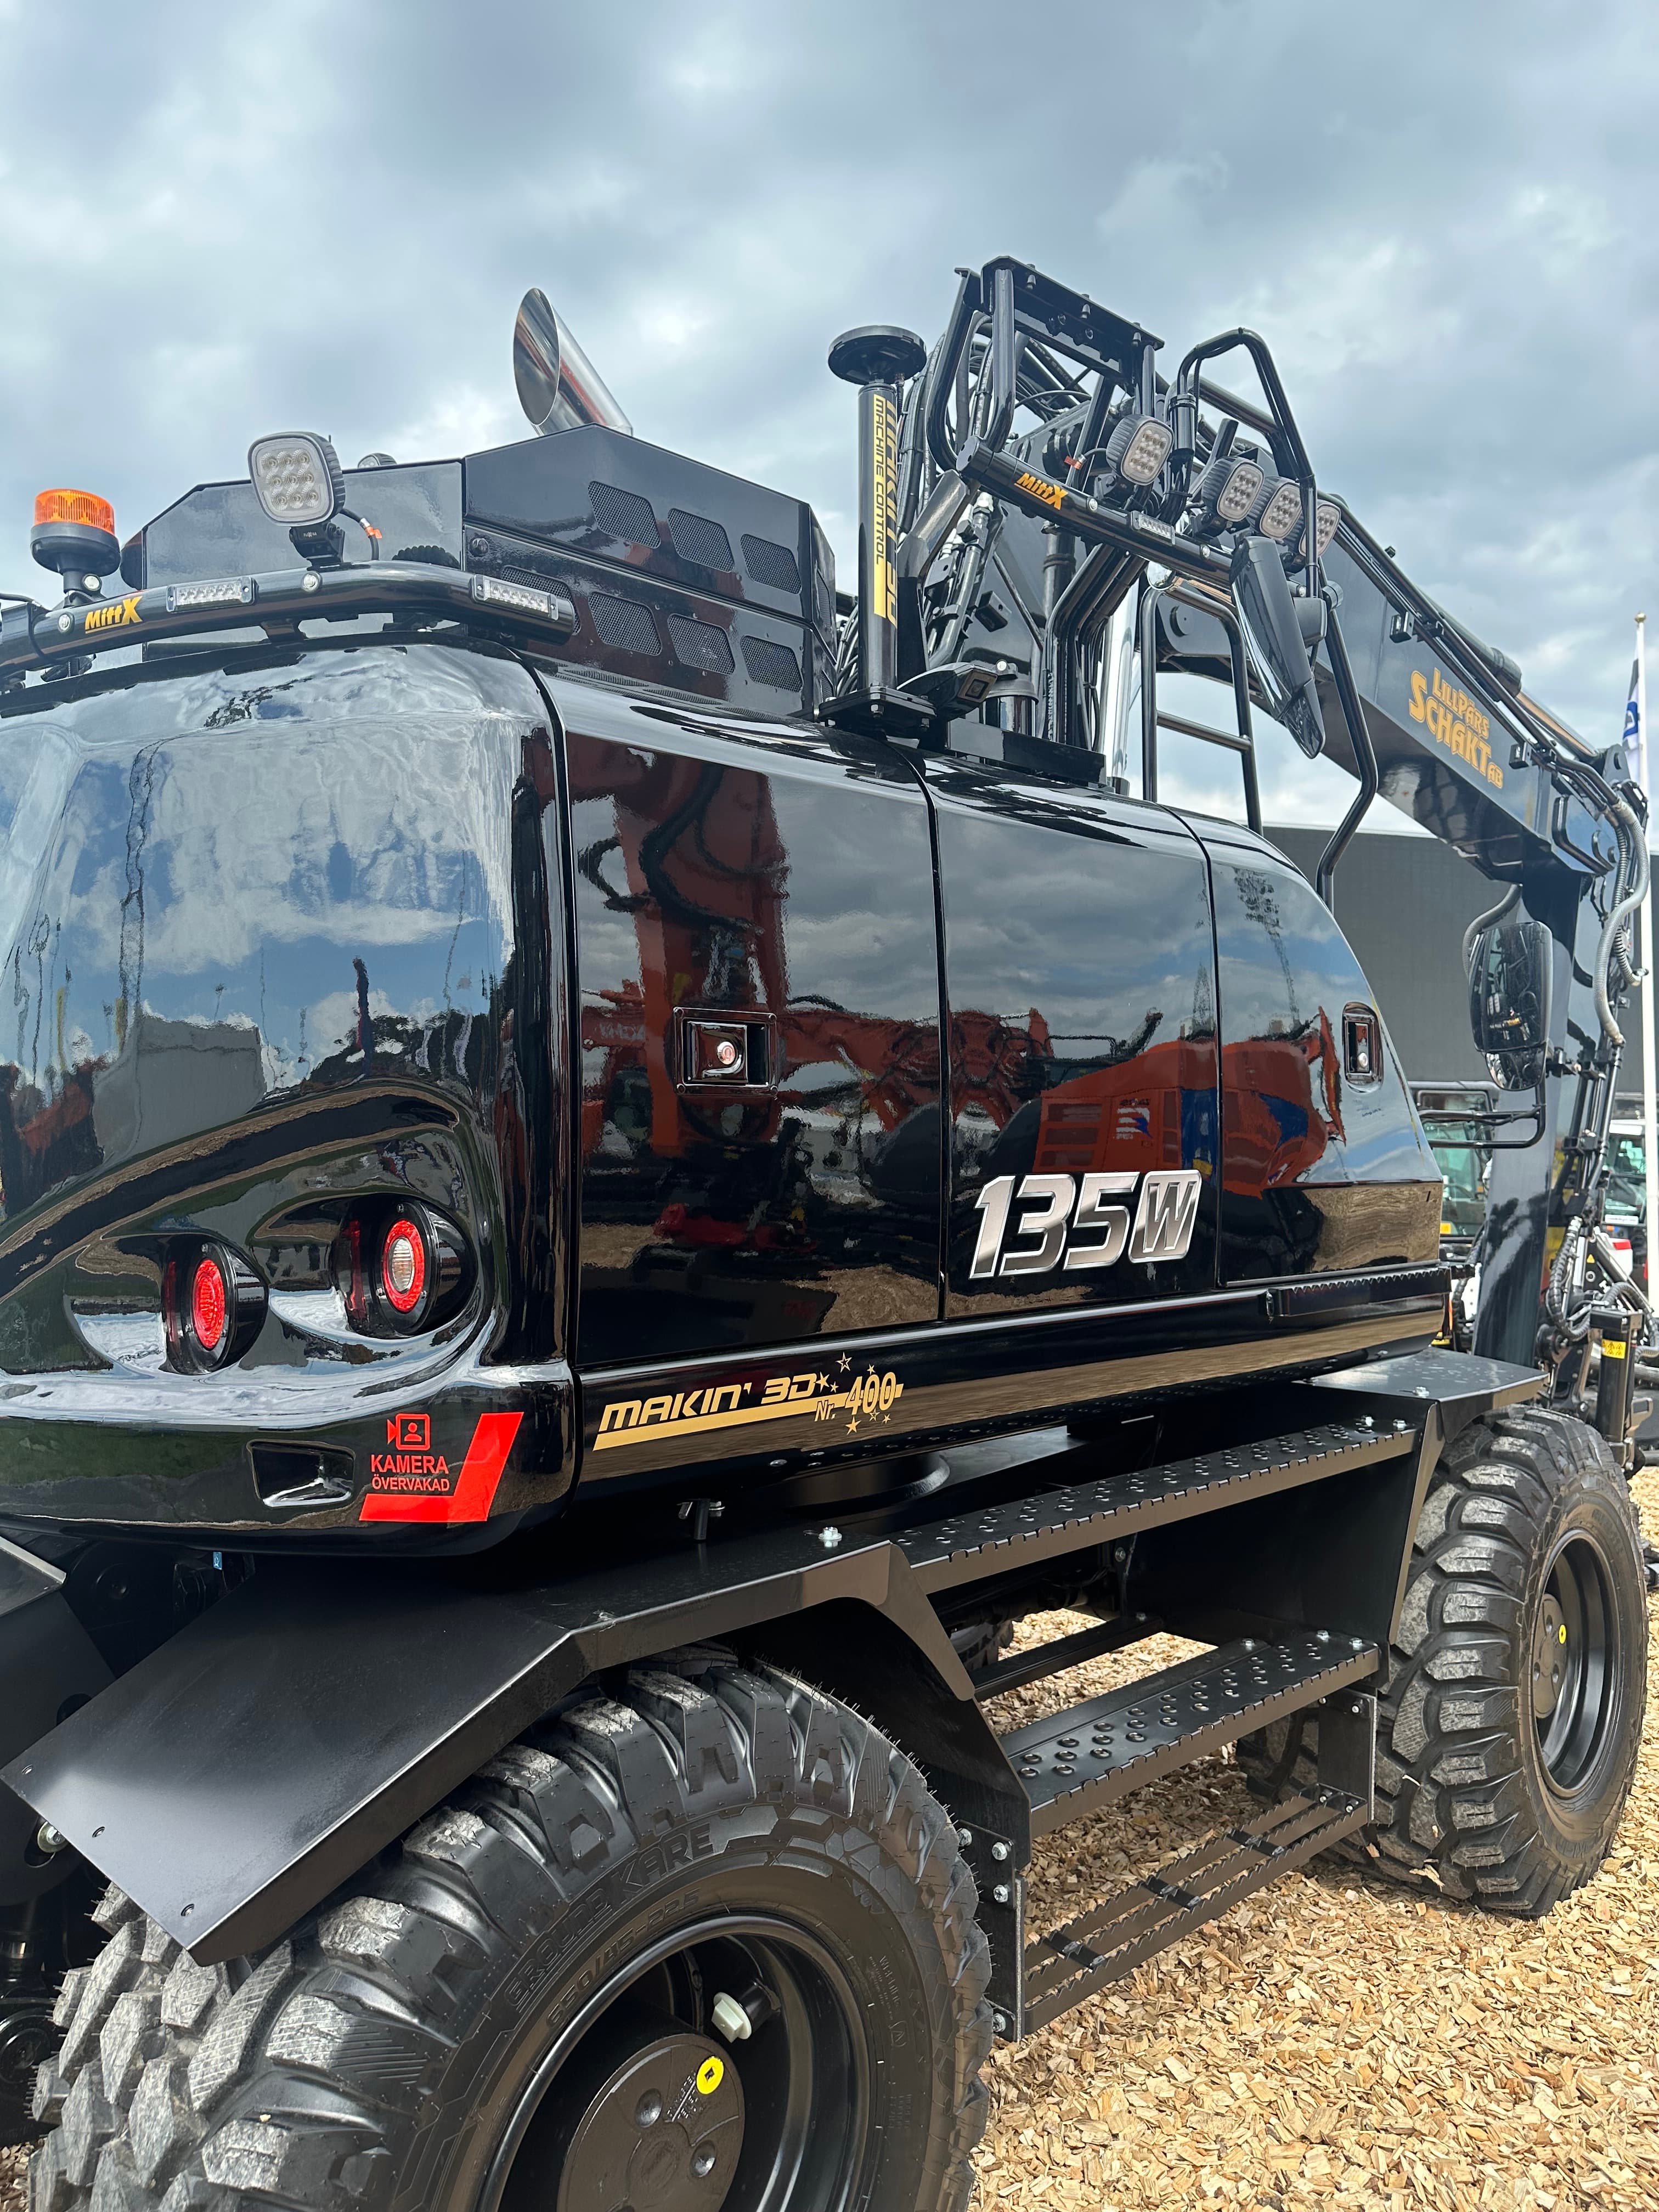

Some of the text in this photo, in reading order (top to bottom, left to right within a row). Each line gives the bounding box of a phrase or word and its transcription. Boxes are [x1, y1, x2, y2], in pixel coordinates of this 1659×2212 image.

[876, 398, 884, 565] MACHINE CONTROL
[1014, 472, 1069, 510] MittX
[85, 596, 143, 634] MittX
[1409, 670, 1492, 776] SCHAKT
[968, 1170, 1202, 1280] 135W
[598, 1373, 817, 1432] MAKIN' 3D
[814, 1372, 896, 1422] Nr. 400
[370, 1454, 449, 1474] KAMERA
[371, 1474, 450, 1491] ÖVERVAKAD
[504, 1822, 714, 2007] GROUND KARE
